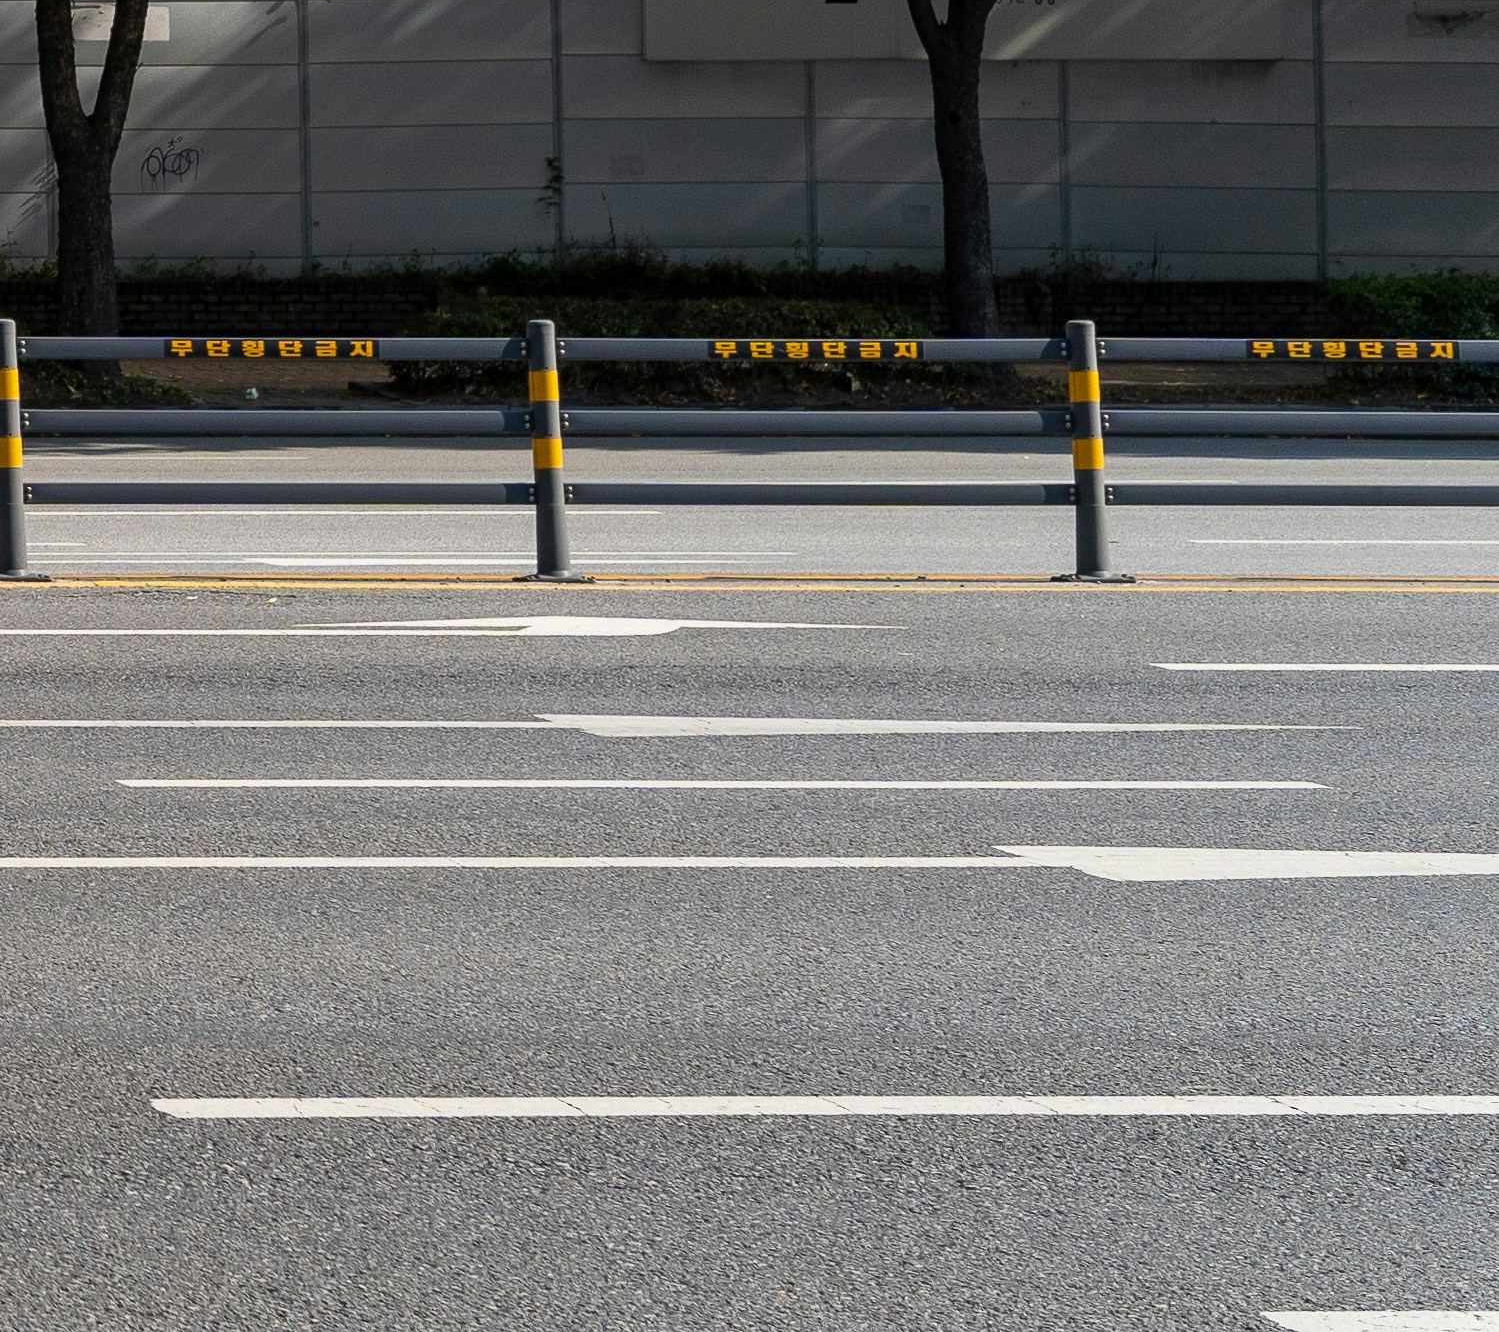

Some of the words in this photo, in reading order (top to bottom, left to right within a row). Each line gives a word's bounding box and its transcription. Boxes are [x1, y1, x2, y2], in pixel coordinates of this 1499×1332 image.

[170, 340, 373, 357] 무단횡단금지
[714, 341, 917, 358] 무단횡단금지
[1251, 341, 1454, 358] 무단횡단금지
